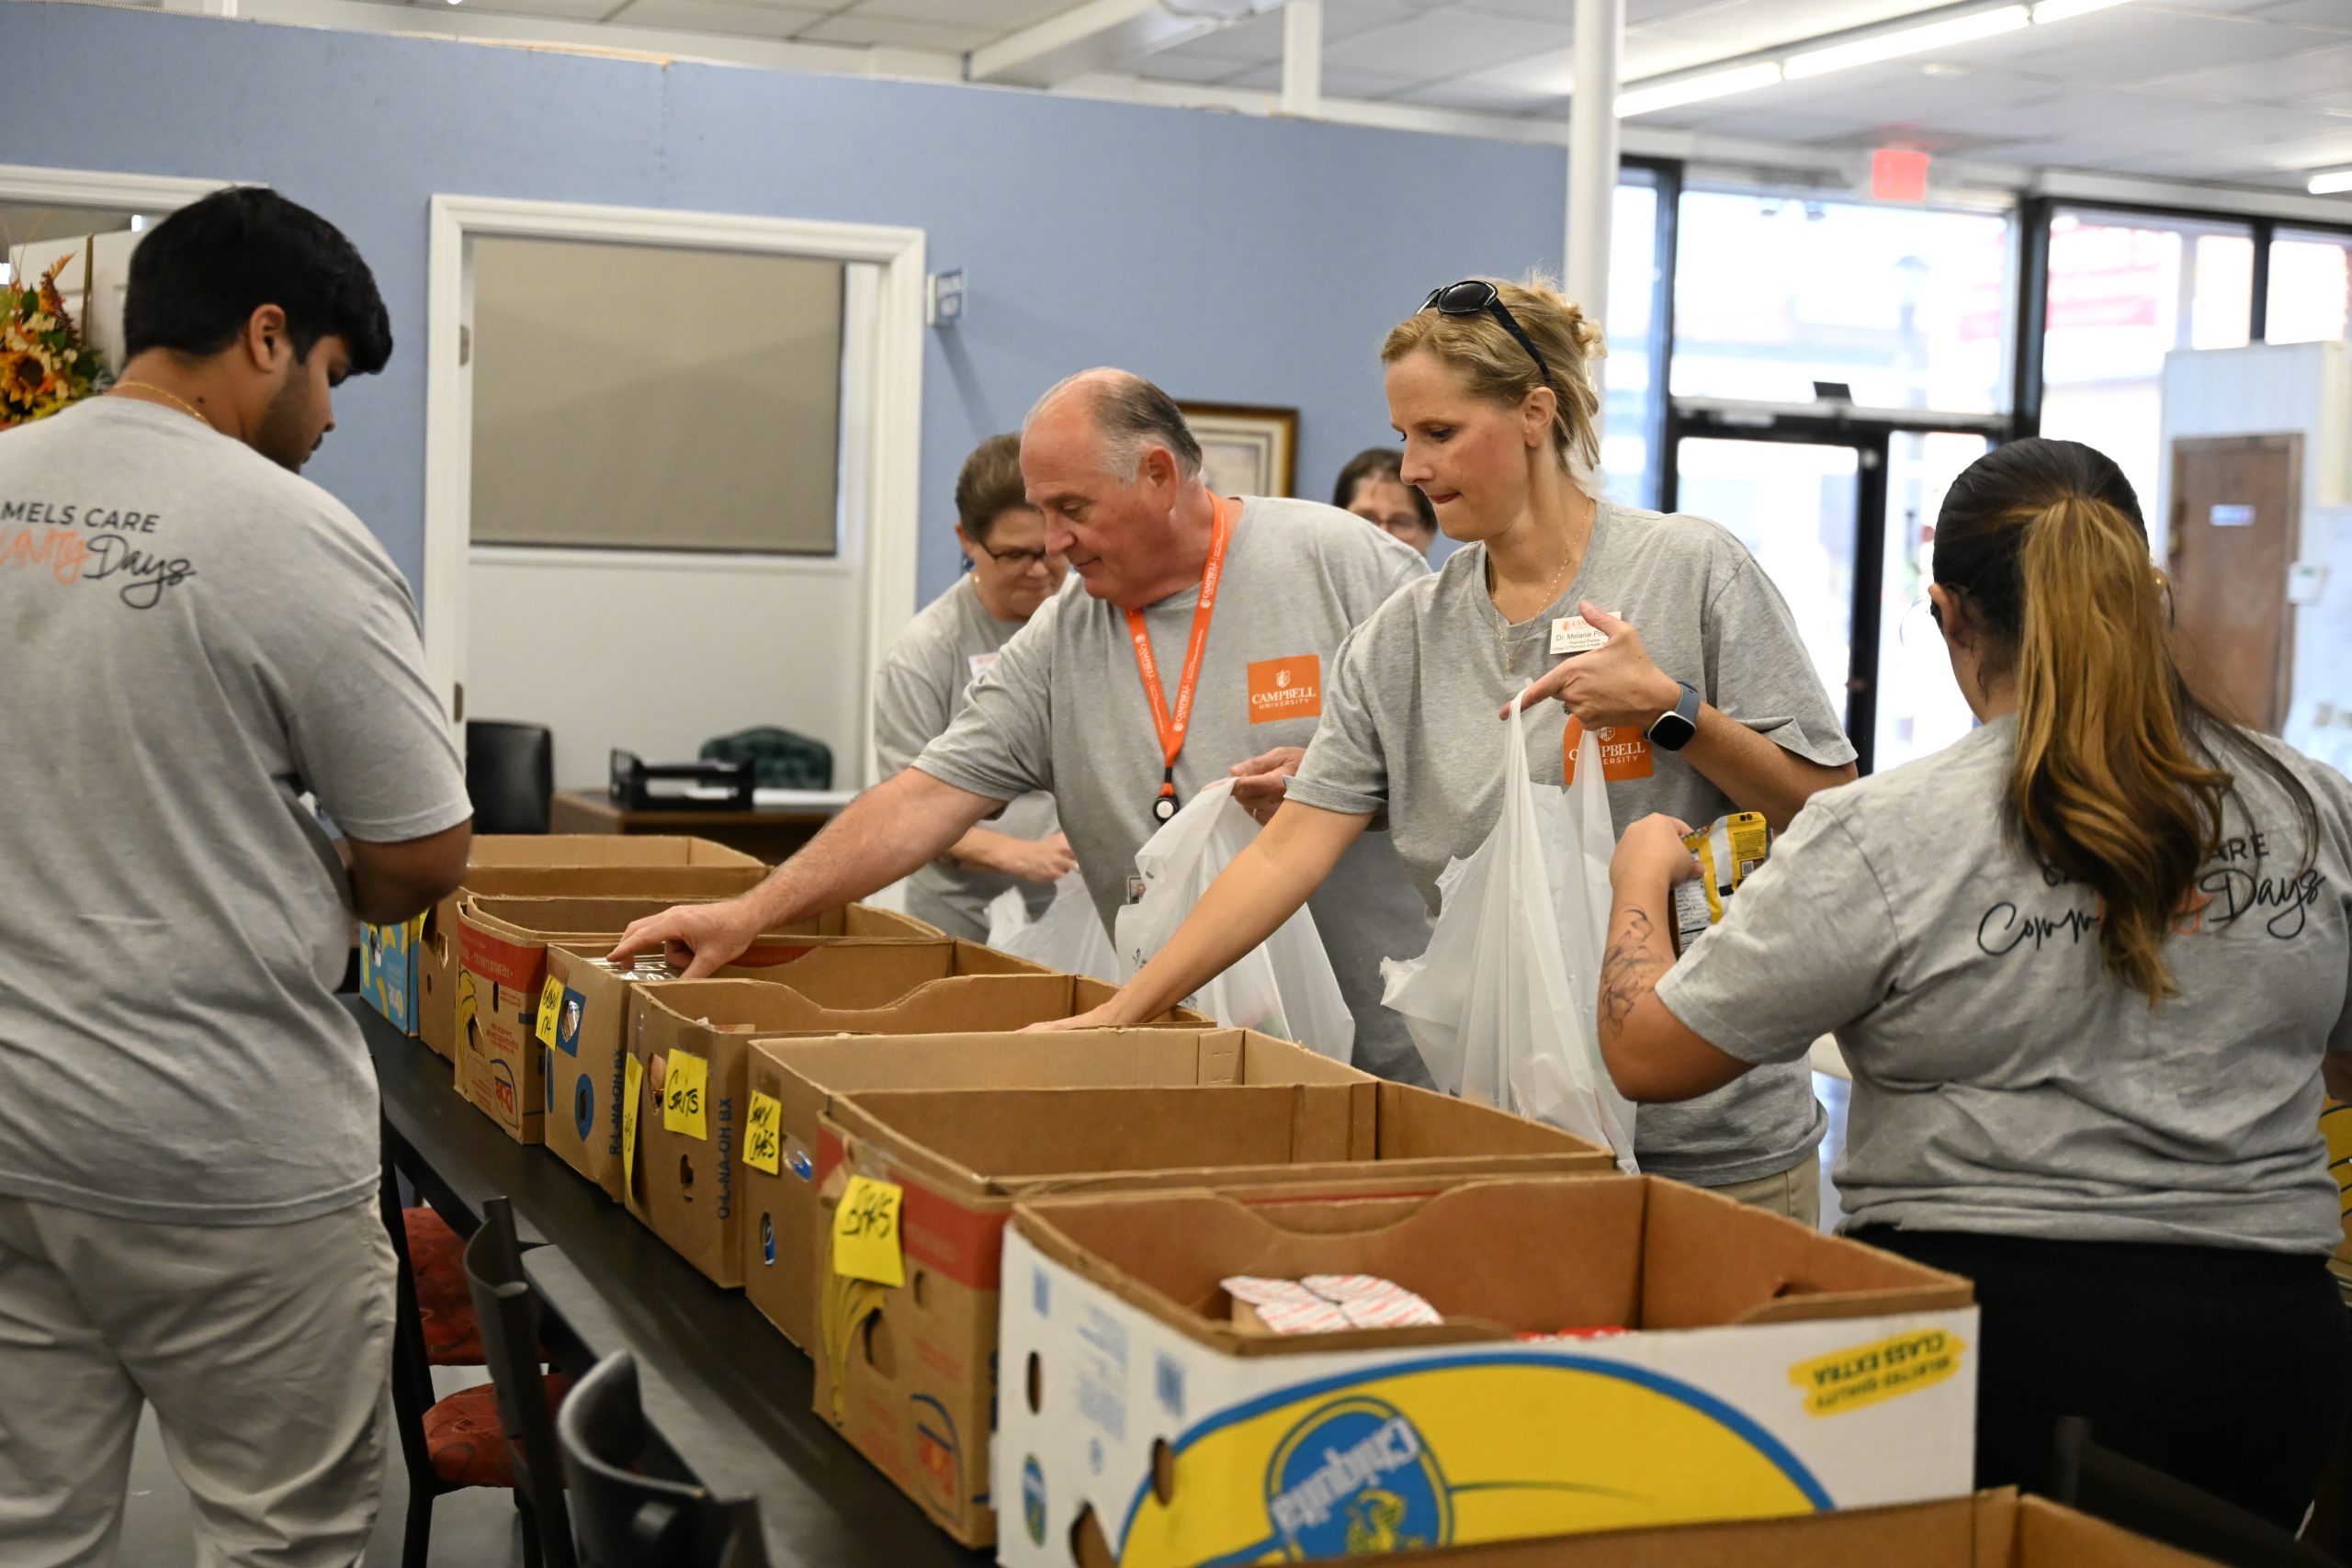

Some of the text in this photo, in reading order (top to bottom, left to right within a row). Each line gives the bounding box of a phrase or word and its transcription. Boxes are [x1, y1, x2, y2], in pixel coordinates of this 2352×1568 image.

[85, 508, 160, 533] CARE
[83, 535, 197, 609] Days
[1251, 686, 1317, 705] CAMPBELL
[1259, 697, 1309, 710] UNIVERSITY
[1568, 741, 1646, 761] CPBELL
[1603, 755, 1638, 765] ERSITY
[2210, 832, 2269, 863] ARE
[2199, 867, 2326, 940] Days
[1813, 1331, 1945, 1386] CLASS EXTRA
[1270, 1416, 1420, 1535] Chiquita
